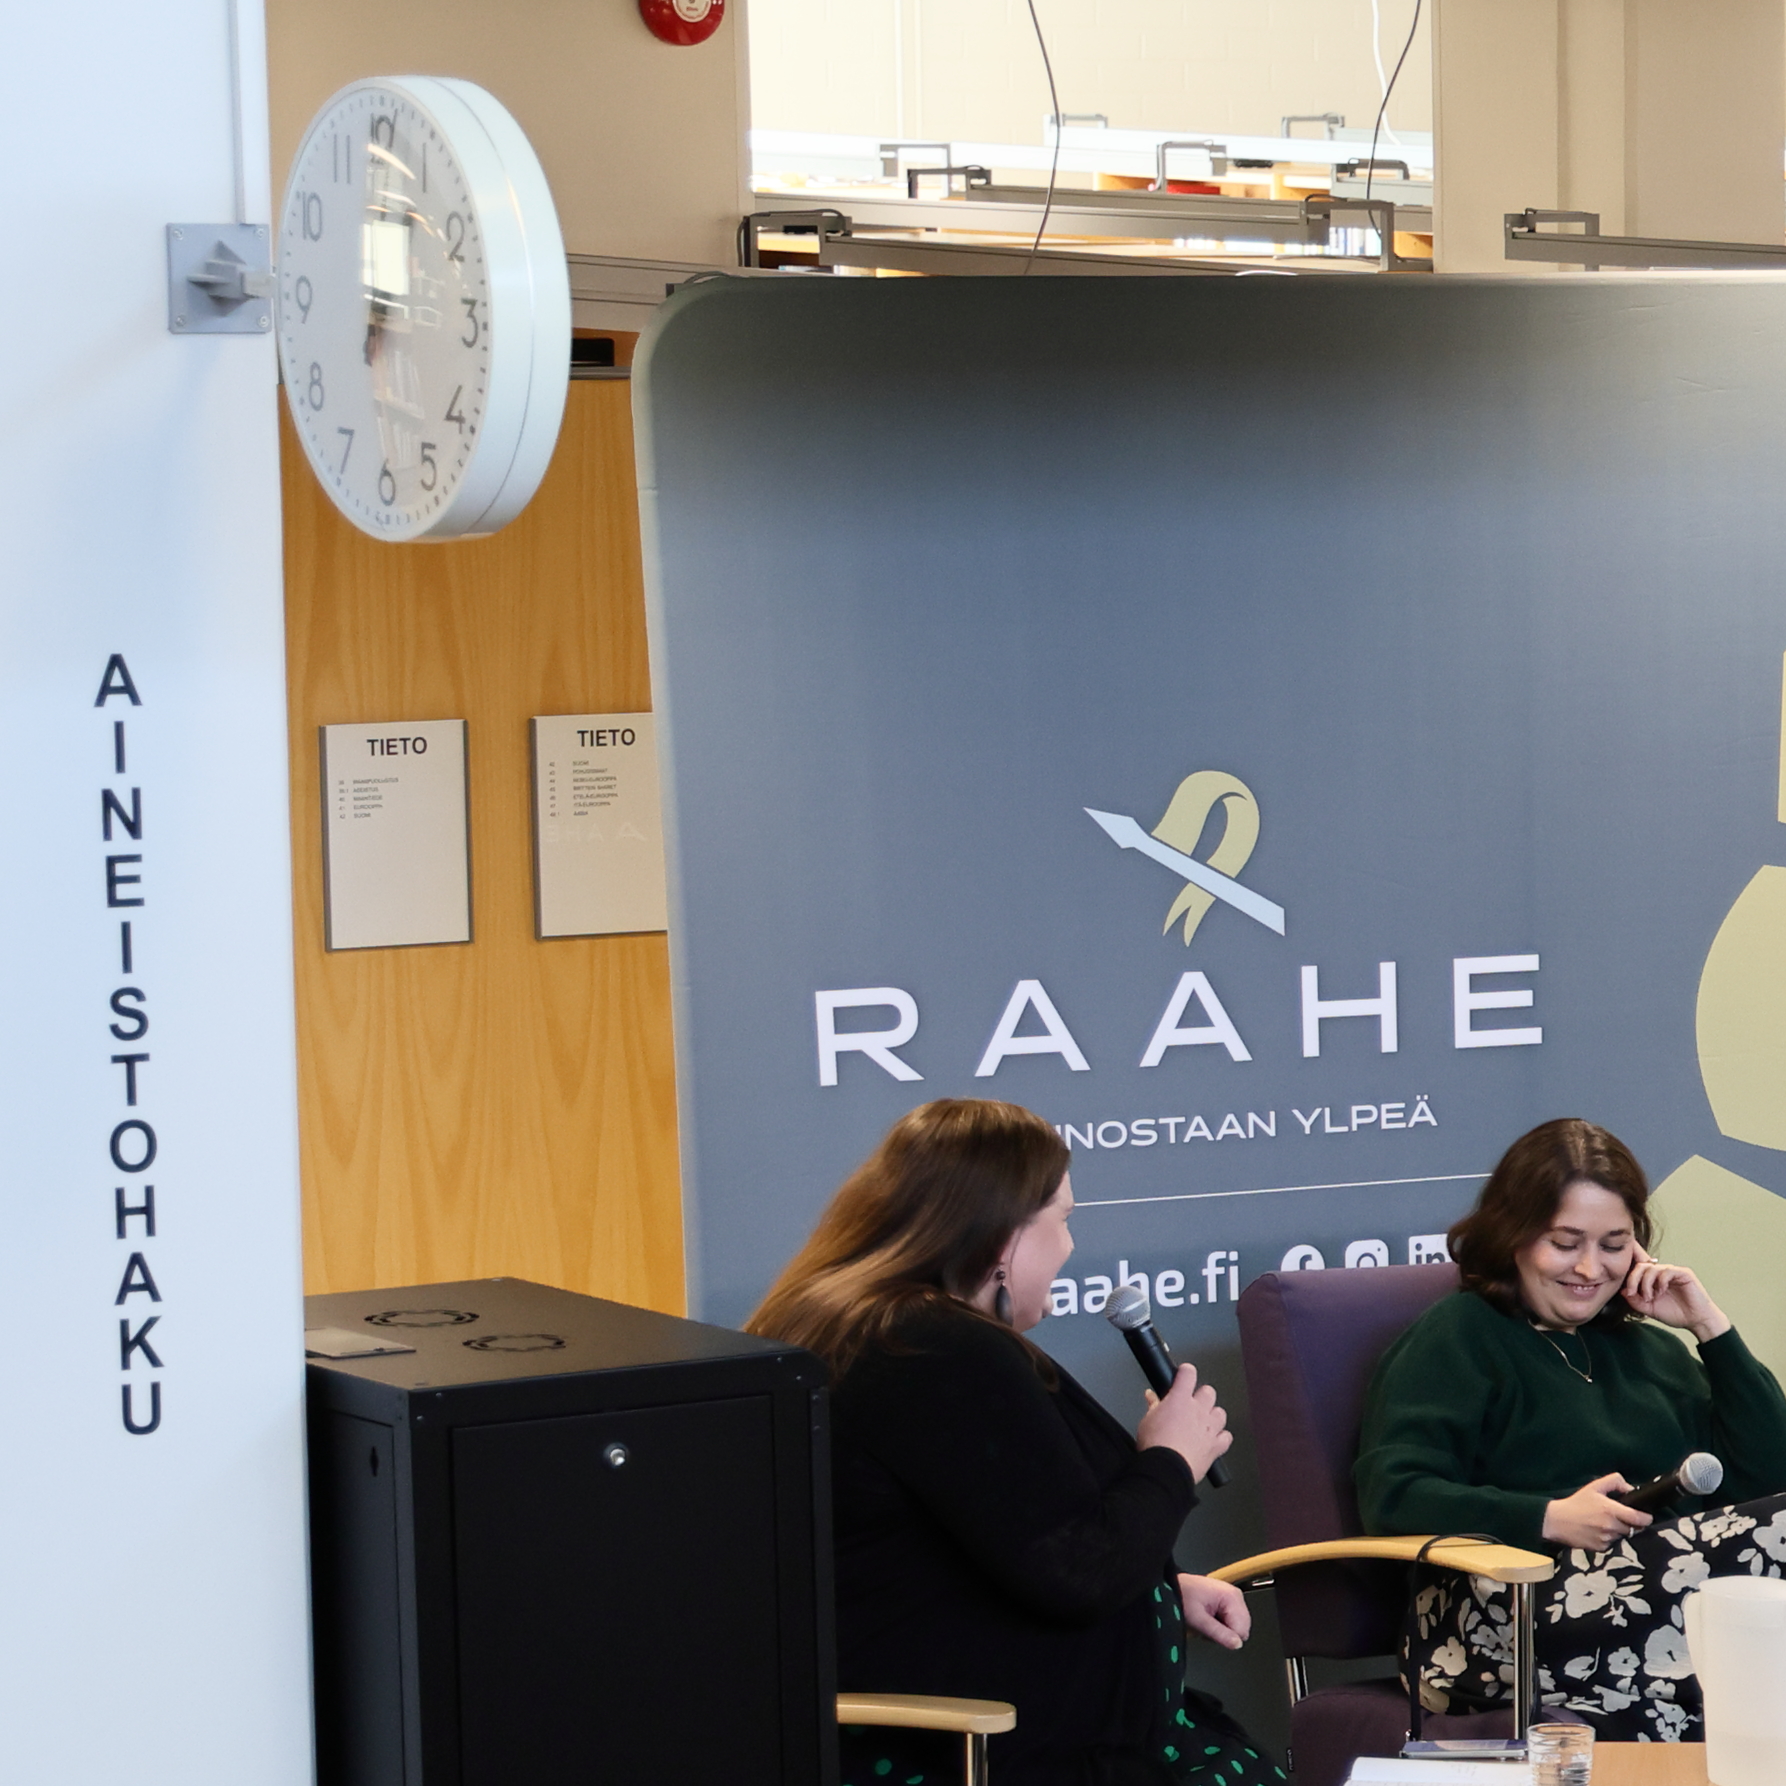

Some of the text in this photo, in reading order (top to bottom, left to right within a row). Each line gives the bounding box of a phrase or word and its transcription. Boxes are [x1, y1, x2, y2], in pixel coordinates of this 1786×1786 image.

[331, 134, 352, 184] 11
[300, 192, 324, 241] 10
[446, 213, 467, 264] 2
[295, 276, 313, 324] 9
[460, 297, 479, 349] 3
[308, 362, 325, 412] 8
[445, 385, 467, 433] 4
[337, 429, 354, 475] 7
[420, 443, 438, 491] 5
[378, 459, 396, 507] 6
[366, 737, 428, 756] TIETO
[577, 728, 636, 747] TIETO
[93, 653, 164, 1437] AINEISTOHAKU
[815, 954, 1544, 1088] RAAHE
[1055, 1094, 1438, 1150] NOSTAAN YLPEÄ
